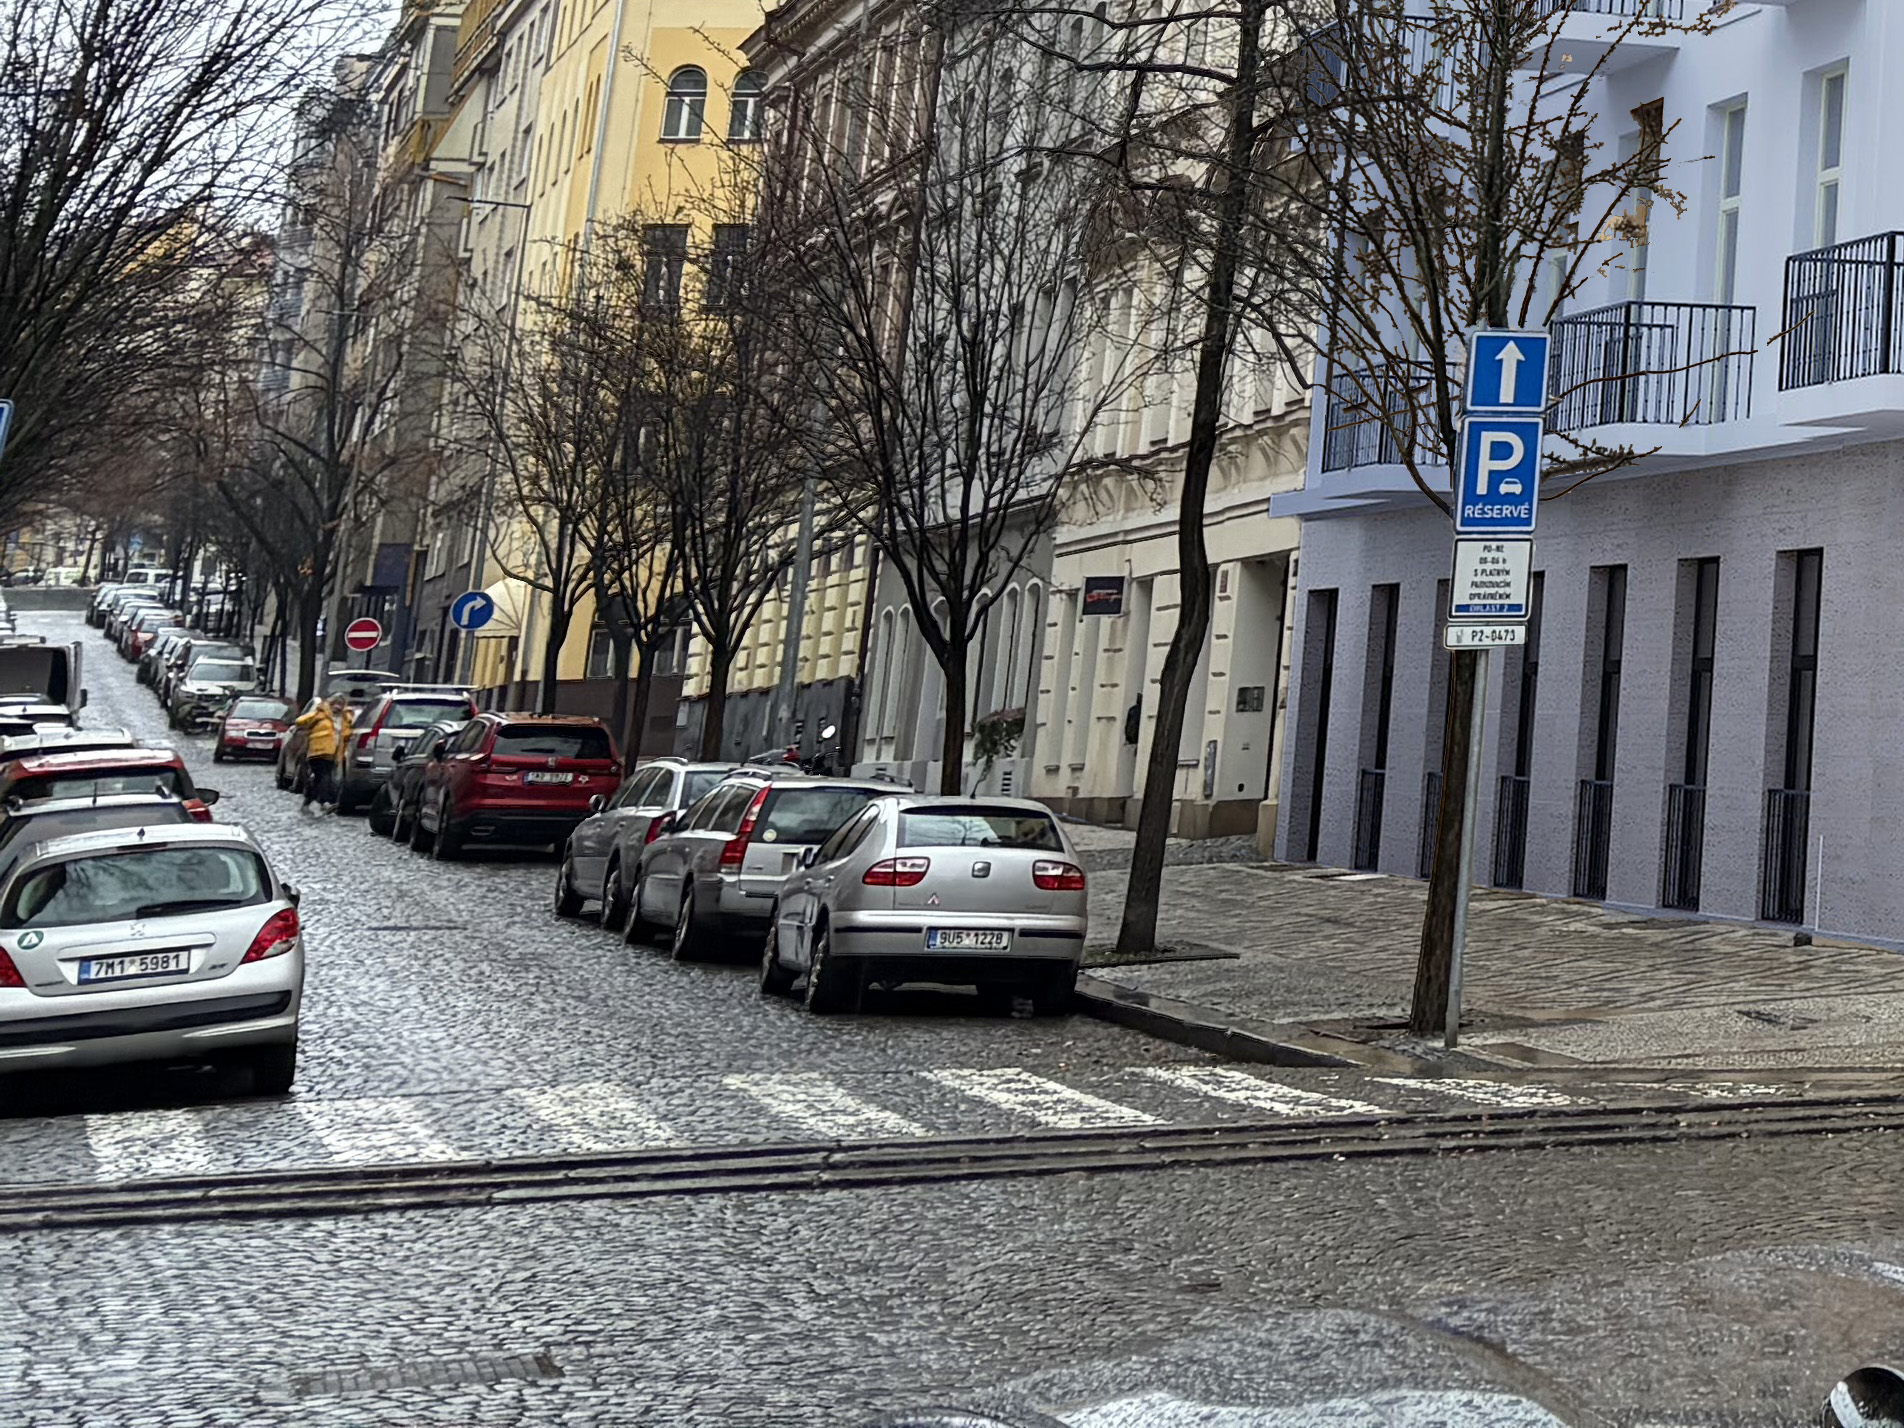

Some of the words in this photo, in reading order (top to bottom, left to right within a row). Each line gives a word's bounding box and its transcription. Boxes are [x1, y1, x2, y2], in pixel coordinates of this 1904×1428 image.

[1476, 430, 1525, 495] P
[1464, 501, 1530, 519] RÉSERVÉ
[940, 931, 964, 945] 9U5
[94, 959, 125, 977] 7M1
[139, 953, 181, 972] 5981
